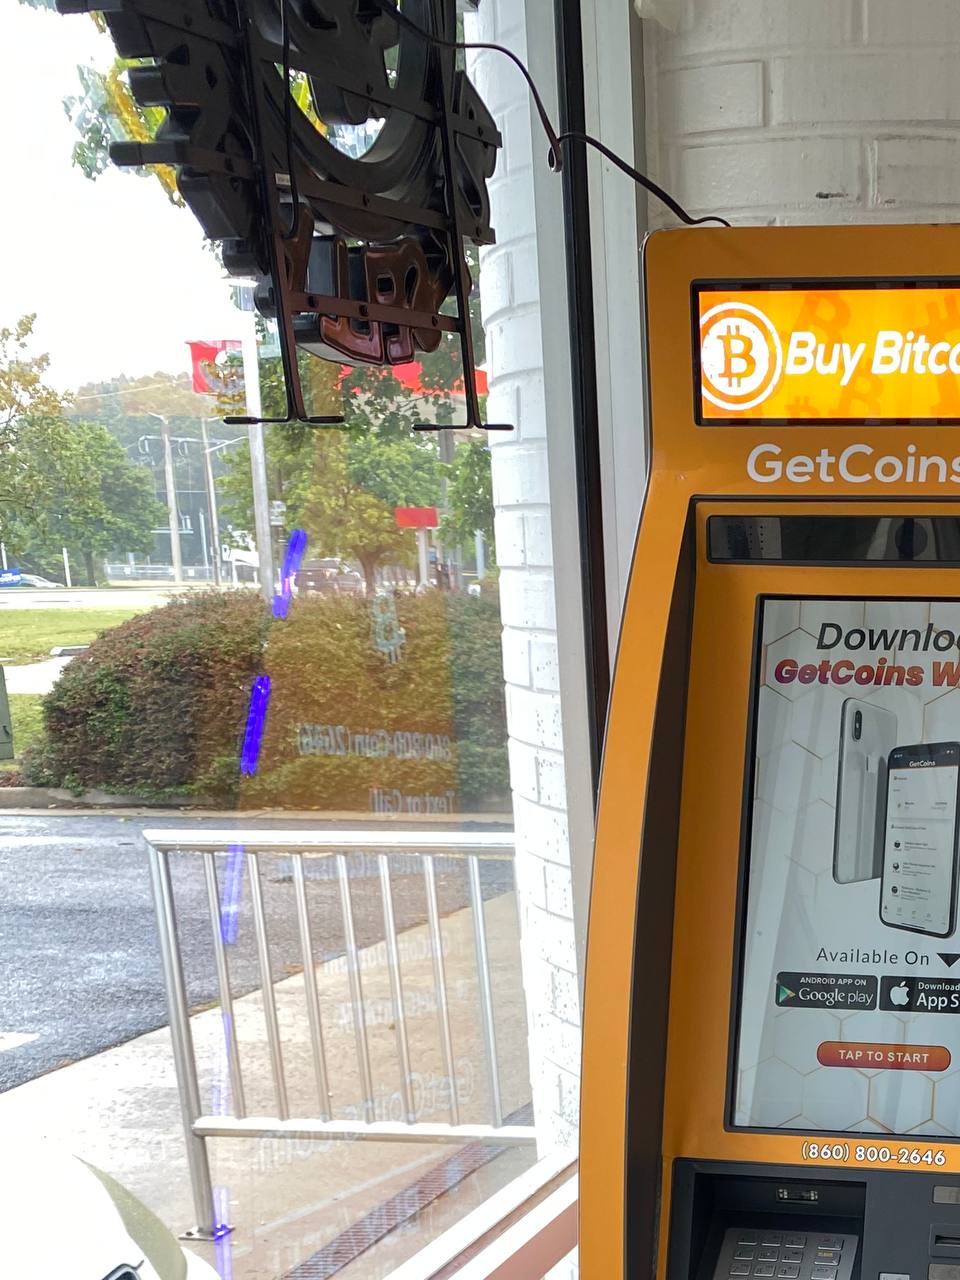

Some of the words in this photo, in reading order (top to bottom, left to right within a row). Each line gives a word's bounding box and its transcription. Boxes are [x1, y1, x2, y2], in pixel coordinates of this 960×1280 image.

[785, 331, 866, 385] Buy
[774, 657, 925, 686] GetCoins
[909, 760, 936, 768] GetCoins
[816, 947, 898, 965] Available
[905, 951, 930, 966] On
[800, 977, 835, 985] ANDROID
[918, 982, 960, 992] Download
[798, 987, 845, 1006] Google
[847, 989, 874, 1006] play
[916, 993, 948, 1011] App
[838, 1049, 864, 1061] TAP
[867, 1051, 883, 1061] TO
[887, 1051, 930, 1063] START
[801, 1142, 849, 1161] (860)
[855, 1145, 947, 1166] 800-2646
